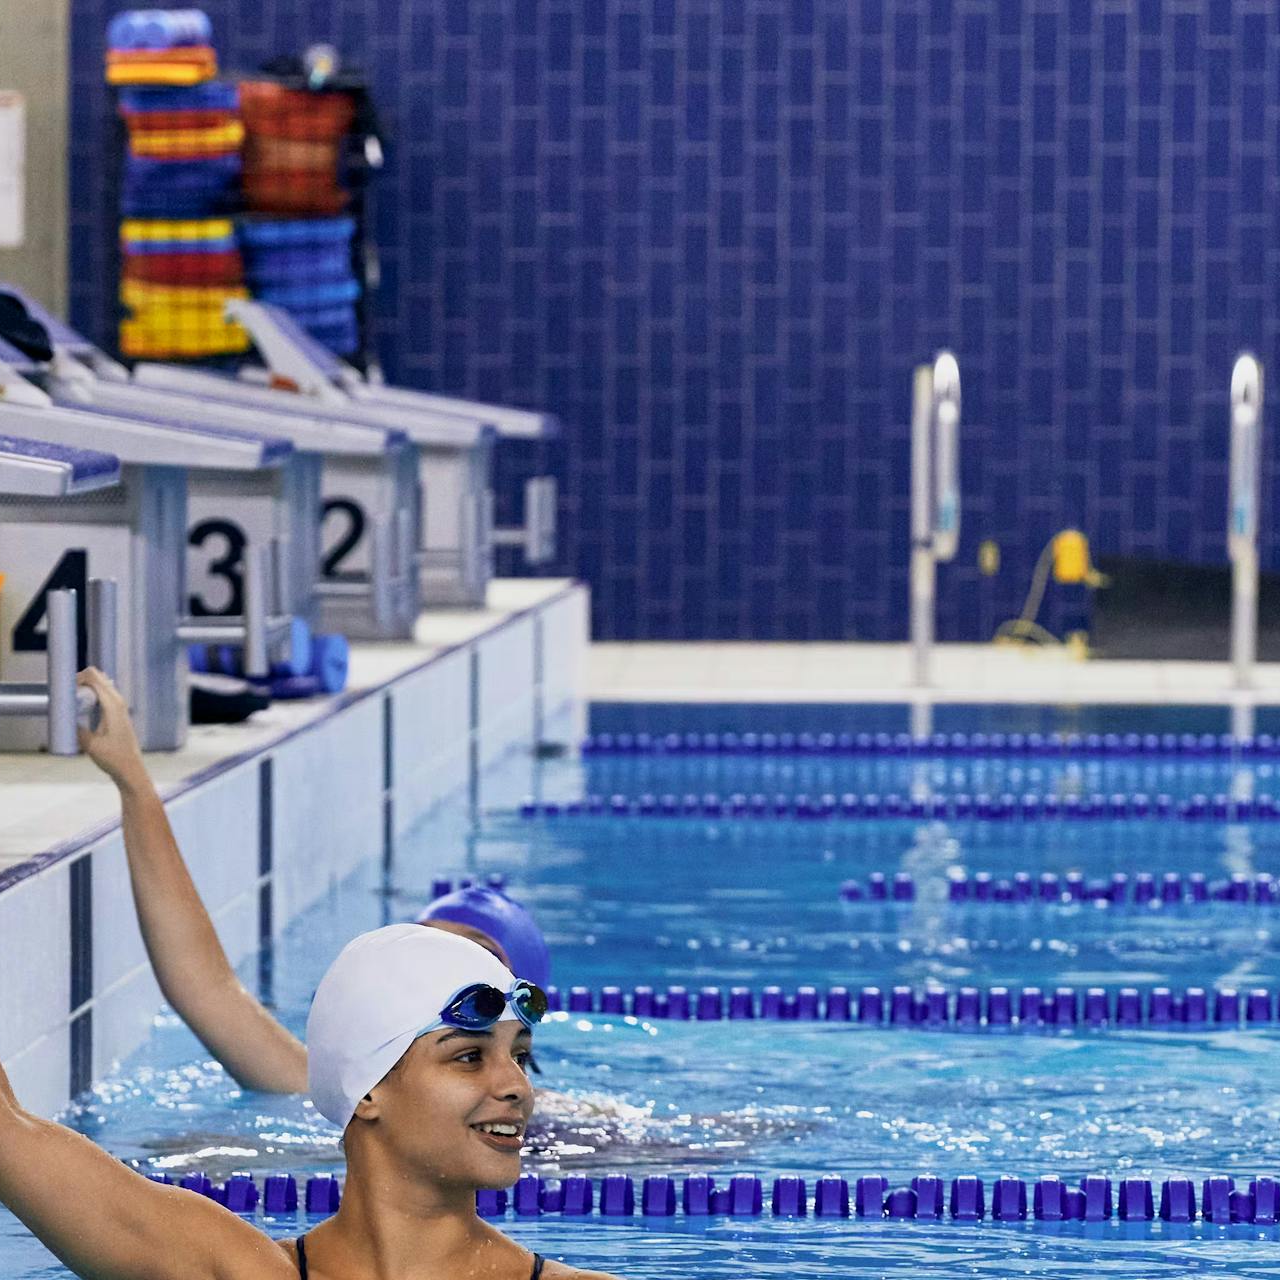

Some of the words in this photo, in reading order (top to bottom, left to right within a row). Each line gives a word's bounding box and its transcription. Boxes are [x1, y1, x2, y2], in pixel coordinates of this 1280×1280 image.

[187, 516, 248, 617] 3
[321, 496, 365, 580] 2
[13, 547, 88, 672] 4
